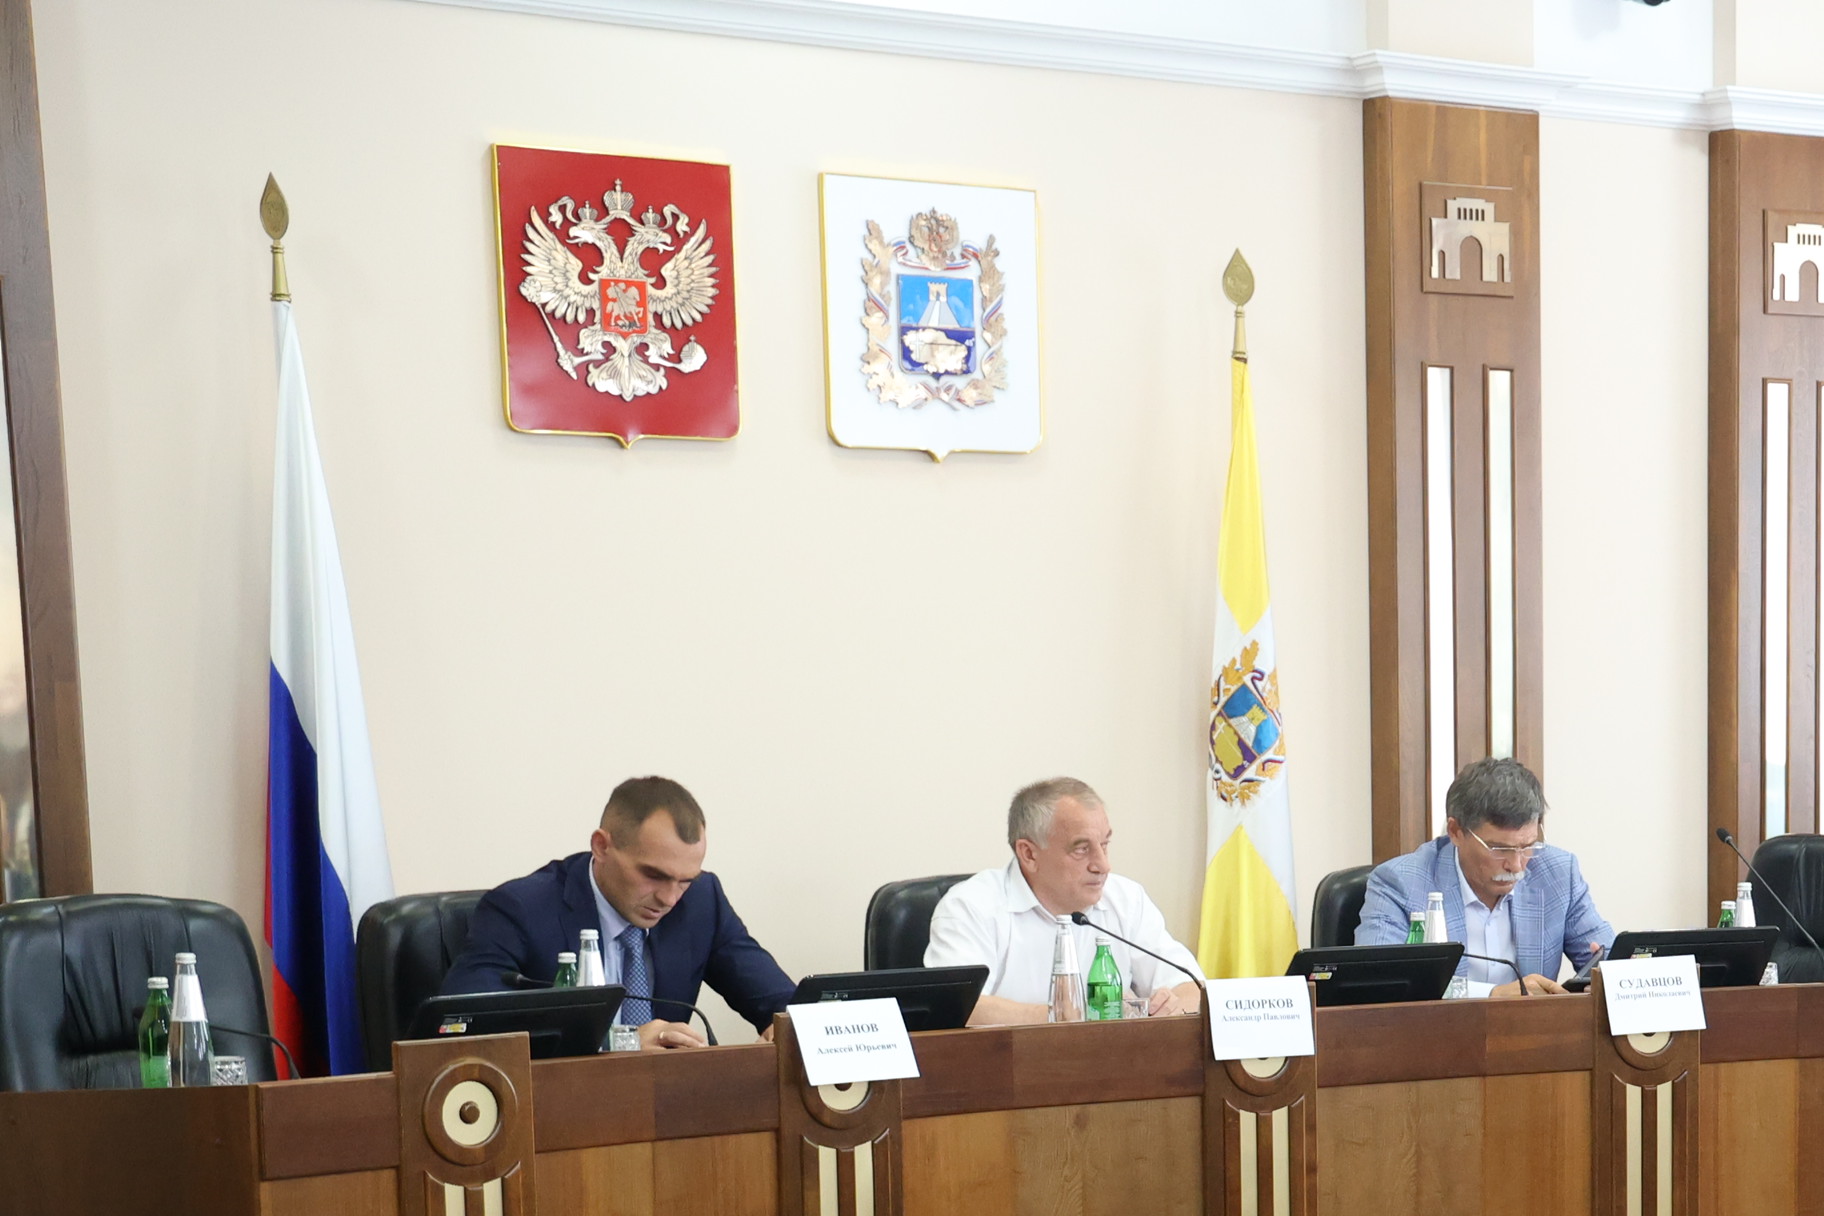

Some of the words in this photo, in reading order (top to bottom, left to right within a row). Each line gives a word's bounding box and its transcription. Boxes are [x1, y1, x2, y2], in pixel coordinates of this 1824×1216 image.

[1619, 976, 1683, 989] СУДАВЦОВ
[1615, 992, 1647, 1001] Дмитрий
[1648, 990, 1691, 999] Николаевич
[1225, 998, 1294, 1011] СИДОРКОВ
[1222, 1013, 1262, 1023] Александр
[1263, 1012, 1300, 1021] Павлович
[824, 1023, 879, 1036] ИВАНОВ
[817, 1045, 854, 1055] Алексей
[856, 1043, 897, 1054] Юрьевич
